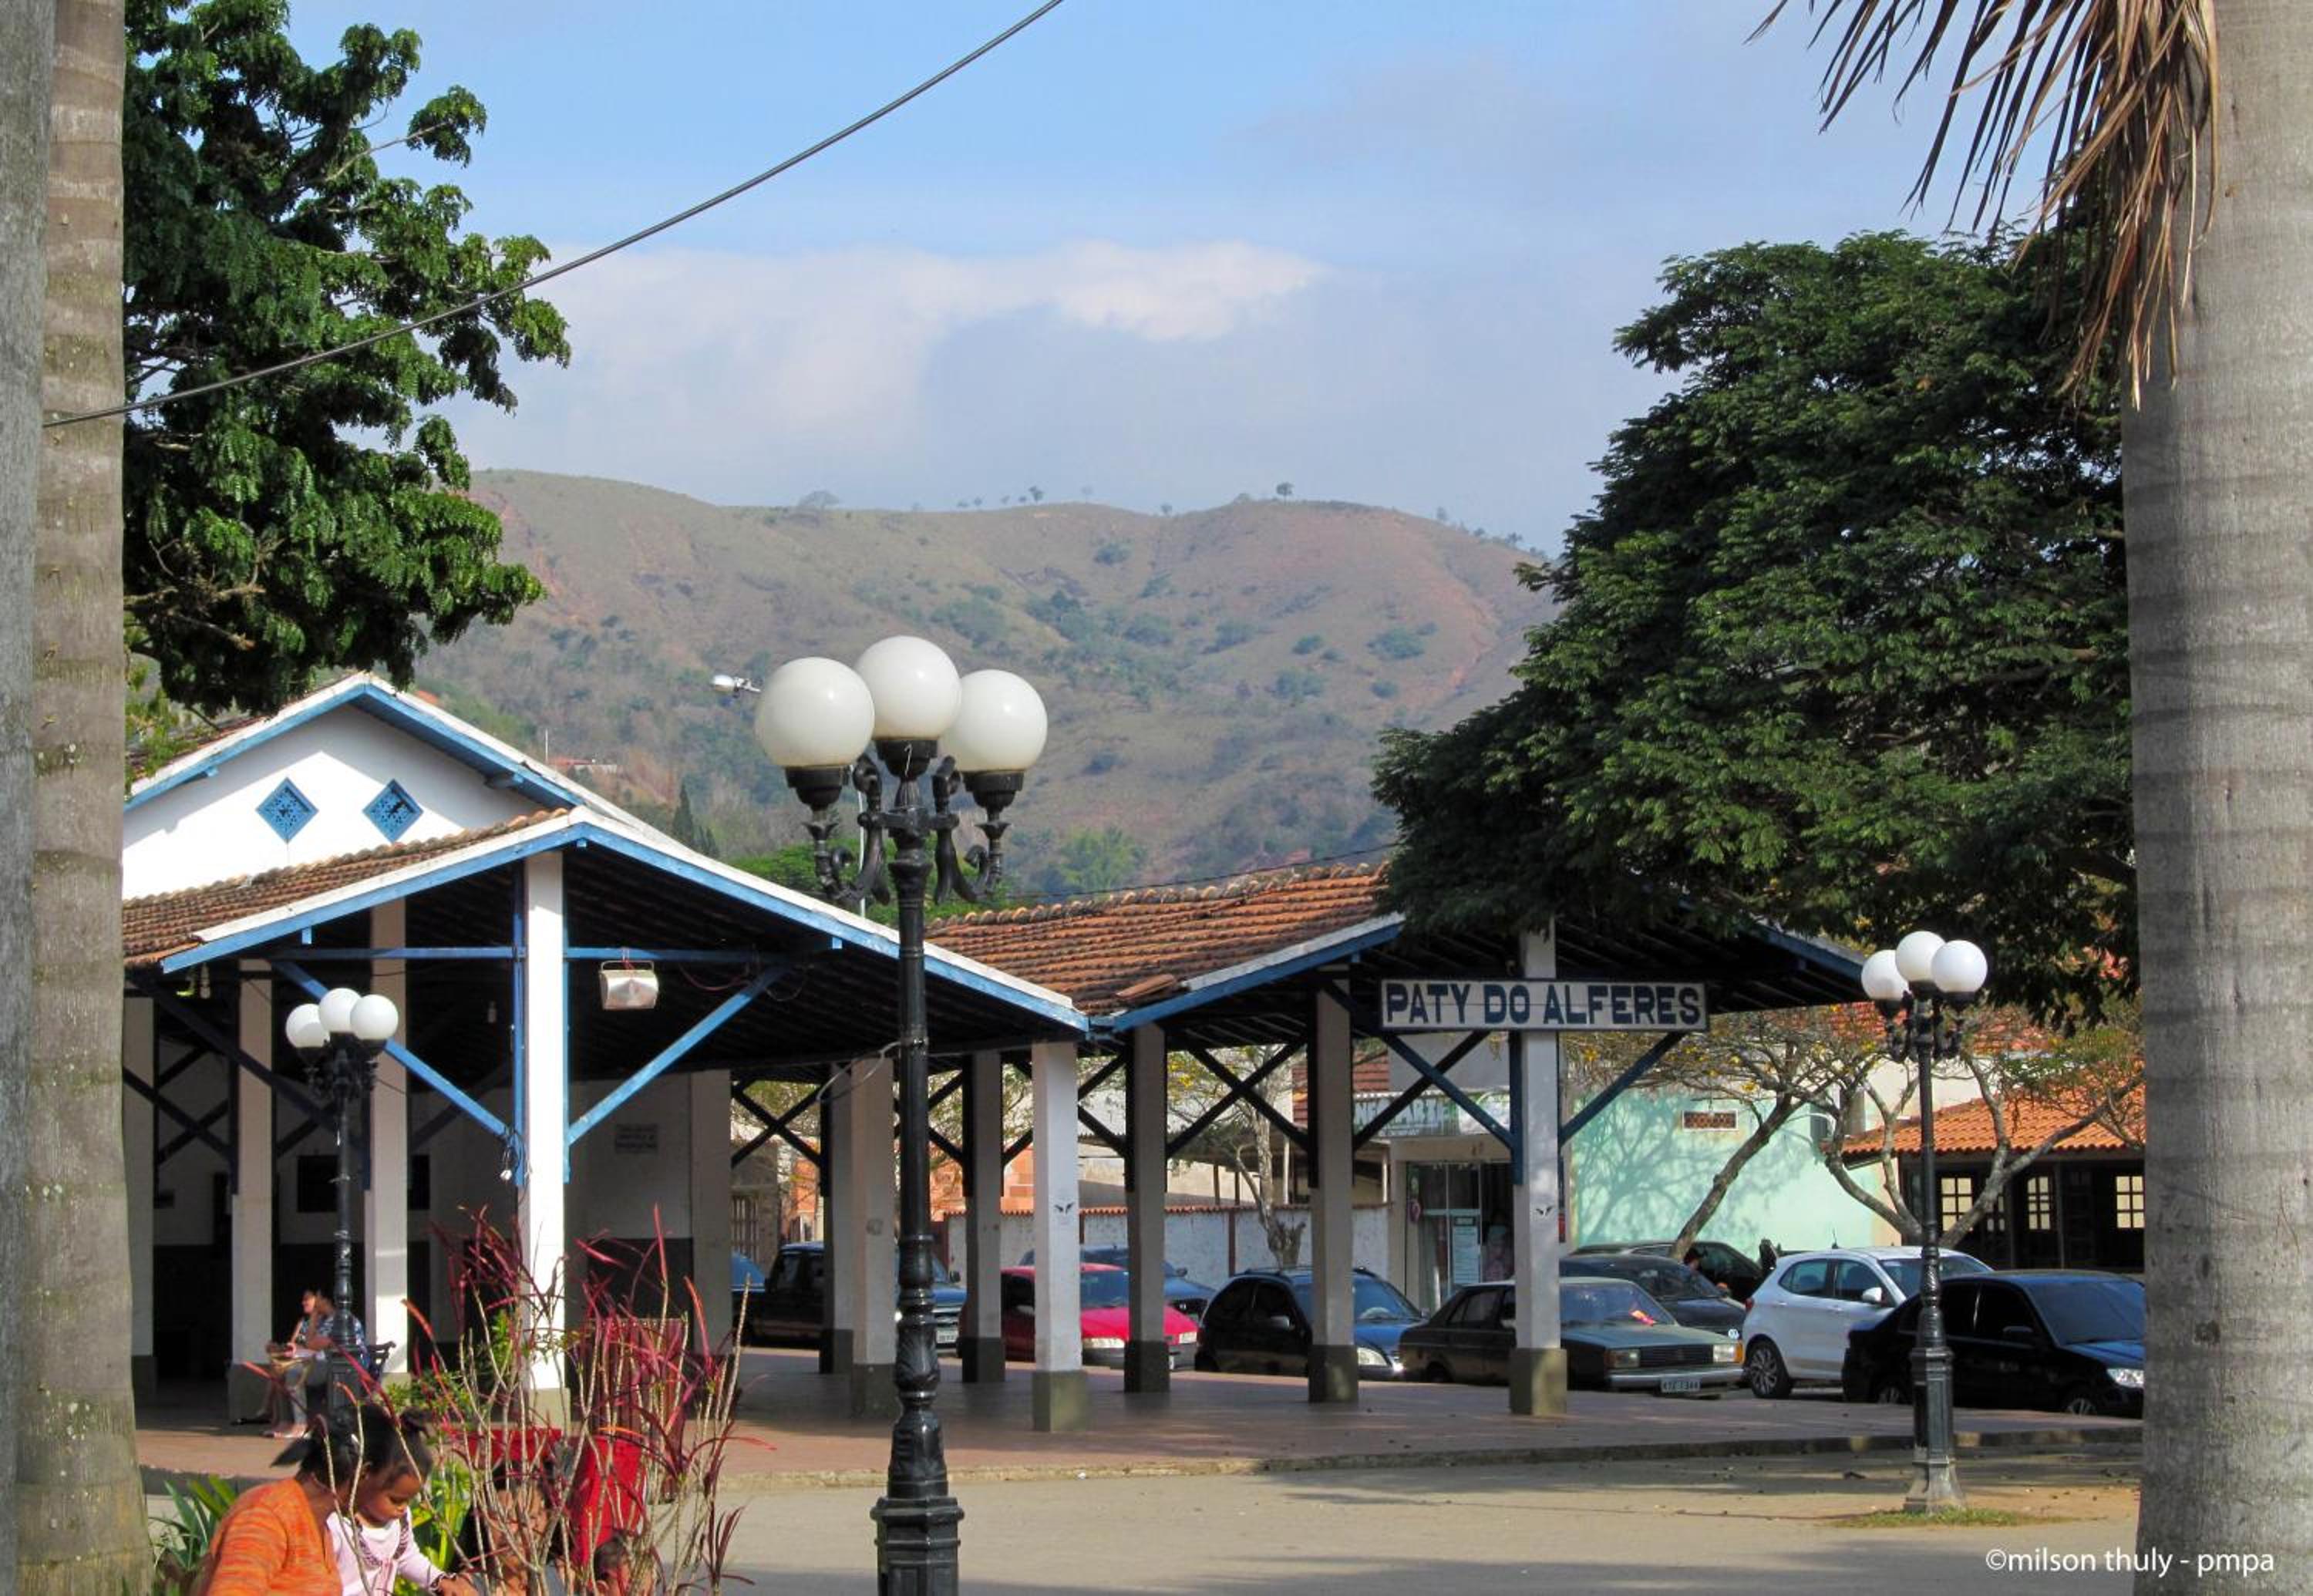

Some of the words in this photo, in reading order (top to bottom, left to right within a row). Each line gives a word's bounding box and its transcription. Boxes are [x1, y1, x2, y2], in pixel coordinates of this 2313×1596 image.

[1386, 983, 1471, 1024] PATY
[1483, 984, 1530, 1024] DO
[1543, 984, 1701, 1025] ALFERES
